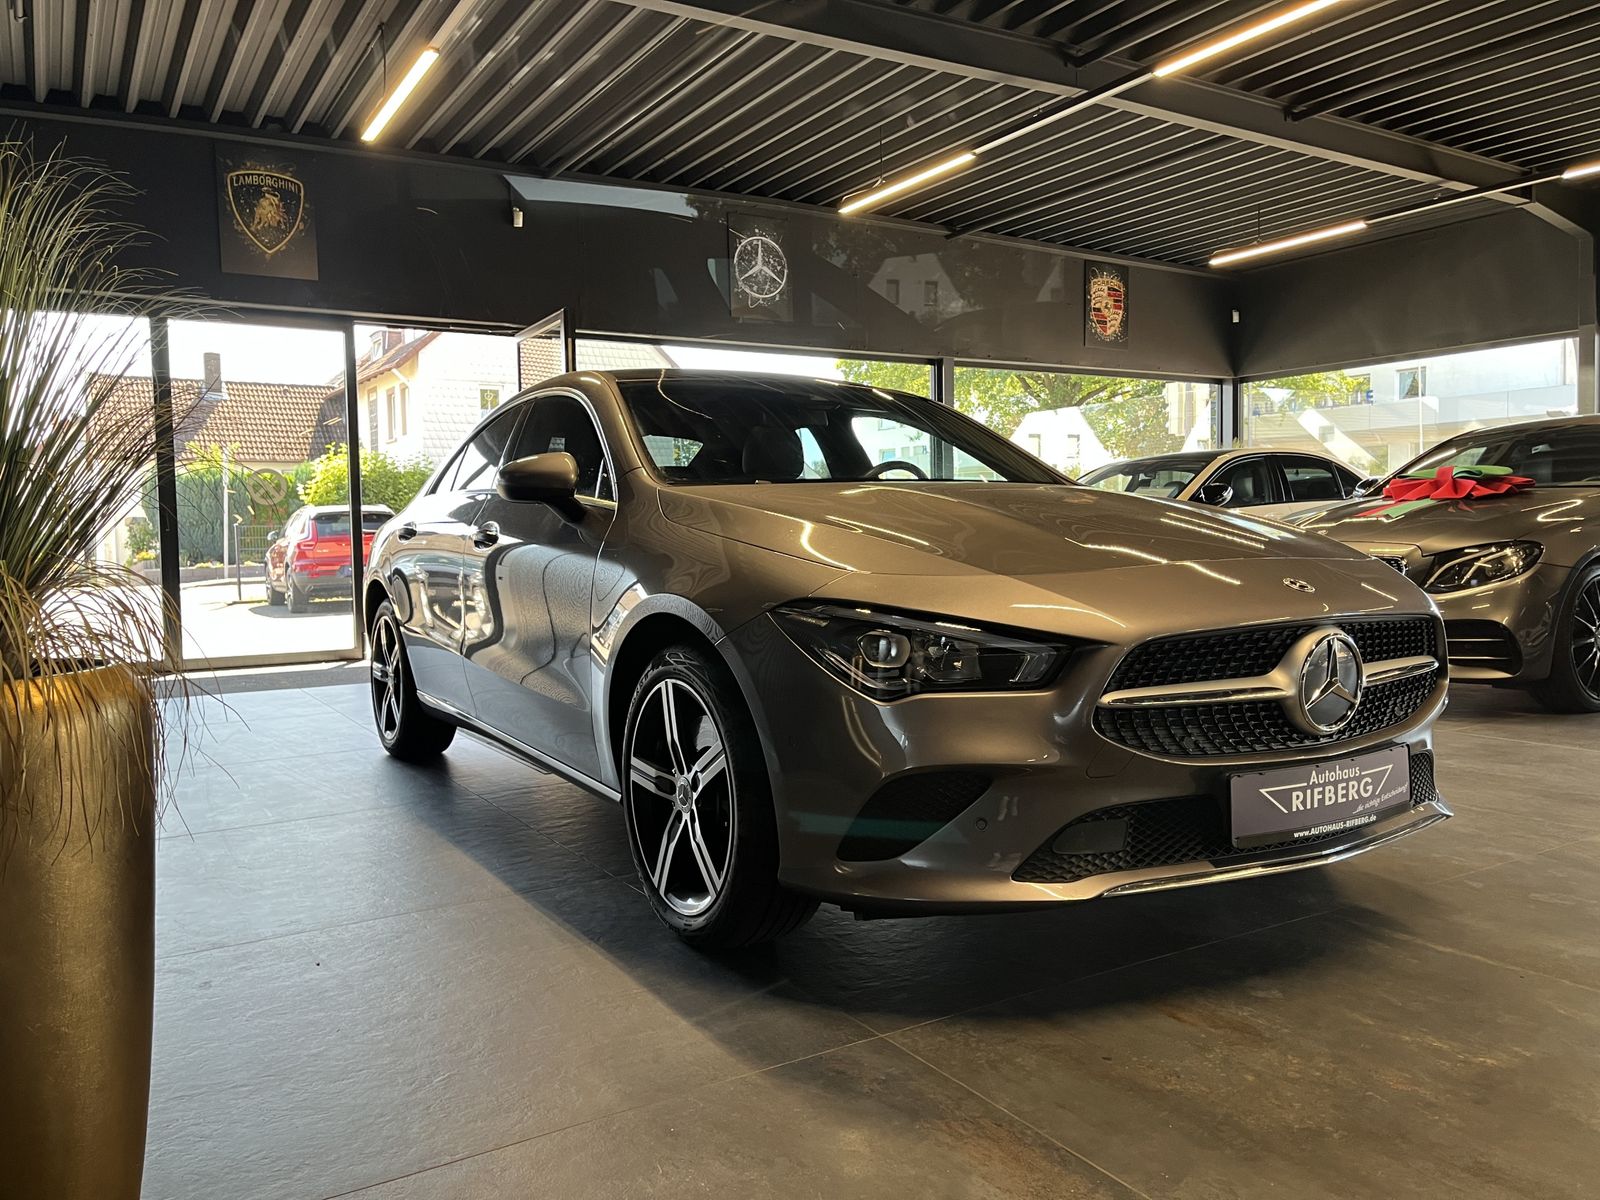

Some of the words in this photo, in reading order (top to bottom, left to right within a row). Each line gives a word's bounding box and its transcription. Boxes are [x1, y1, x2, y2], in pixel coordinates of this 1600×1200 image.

[232, 175, 299, 194] LAMBORGHINI
[1309, 765, 1360, 786] Autohaus
[1292, 777, 1373, 812] RIFBERG
[1293, 814, 1377, 838] www.AUTOHAUS-RIFBERG.de
